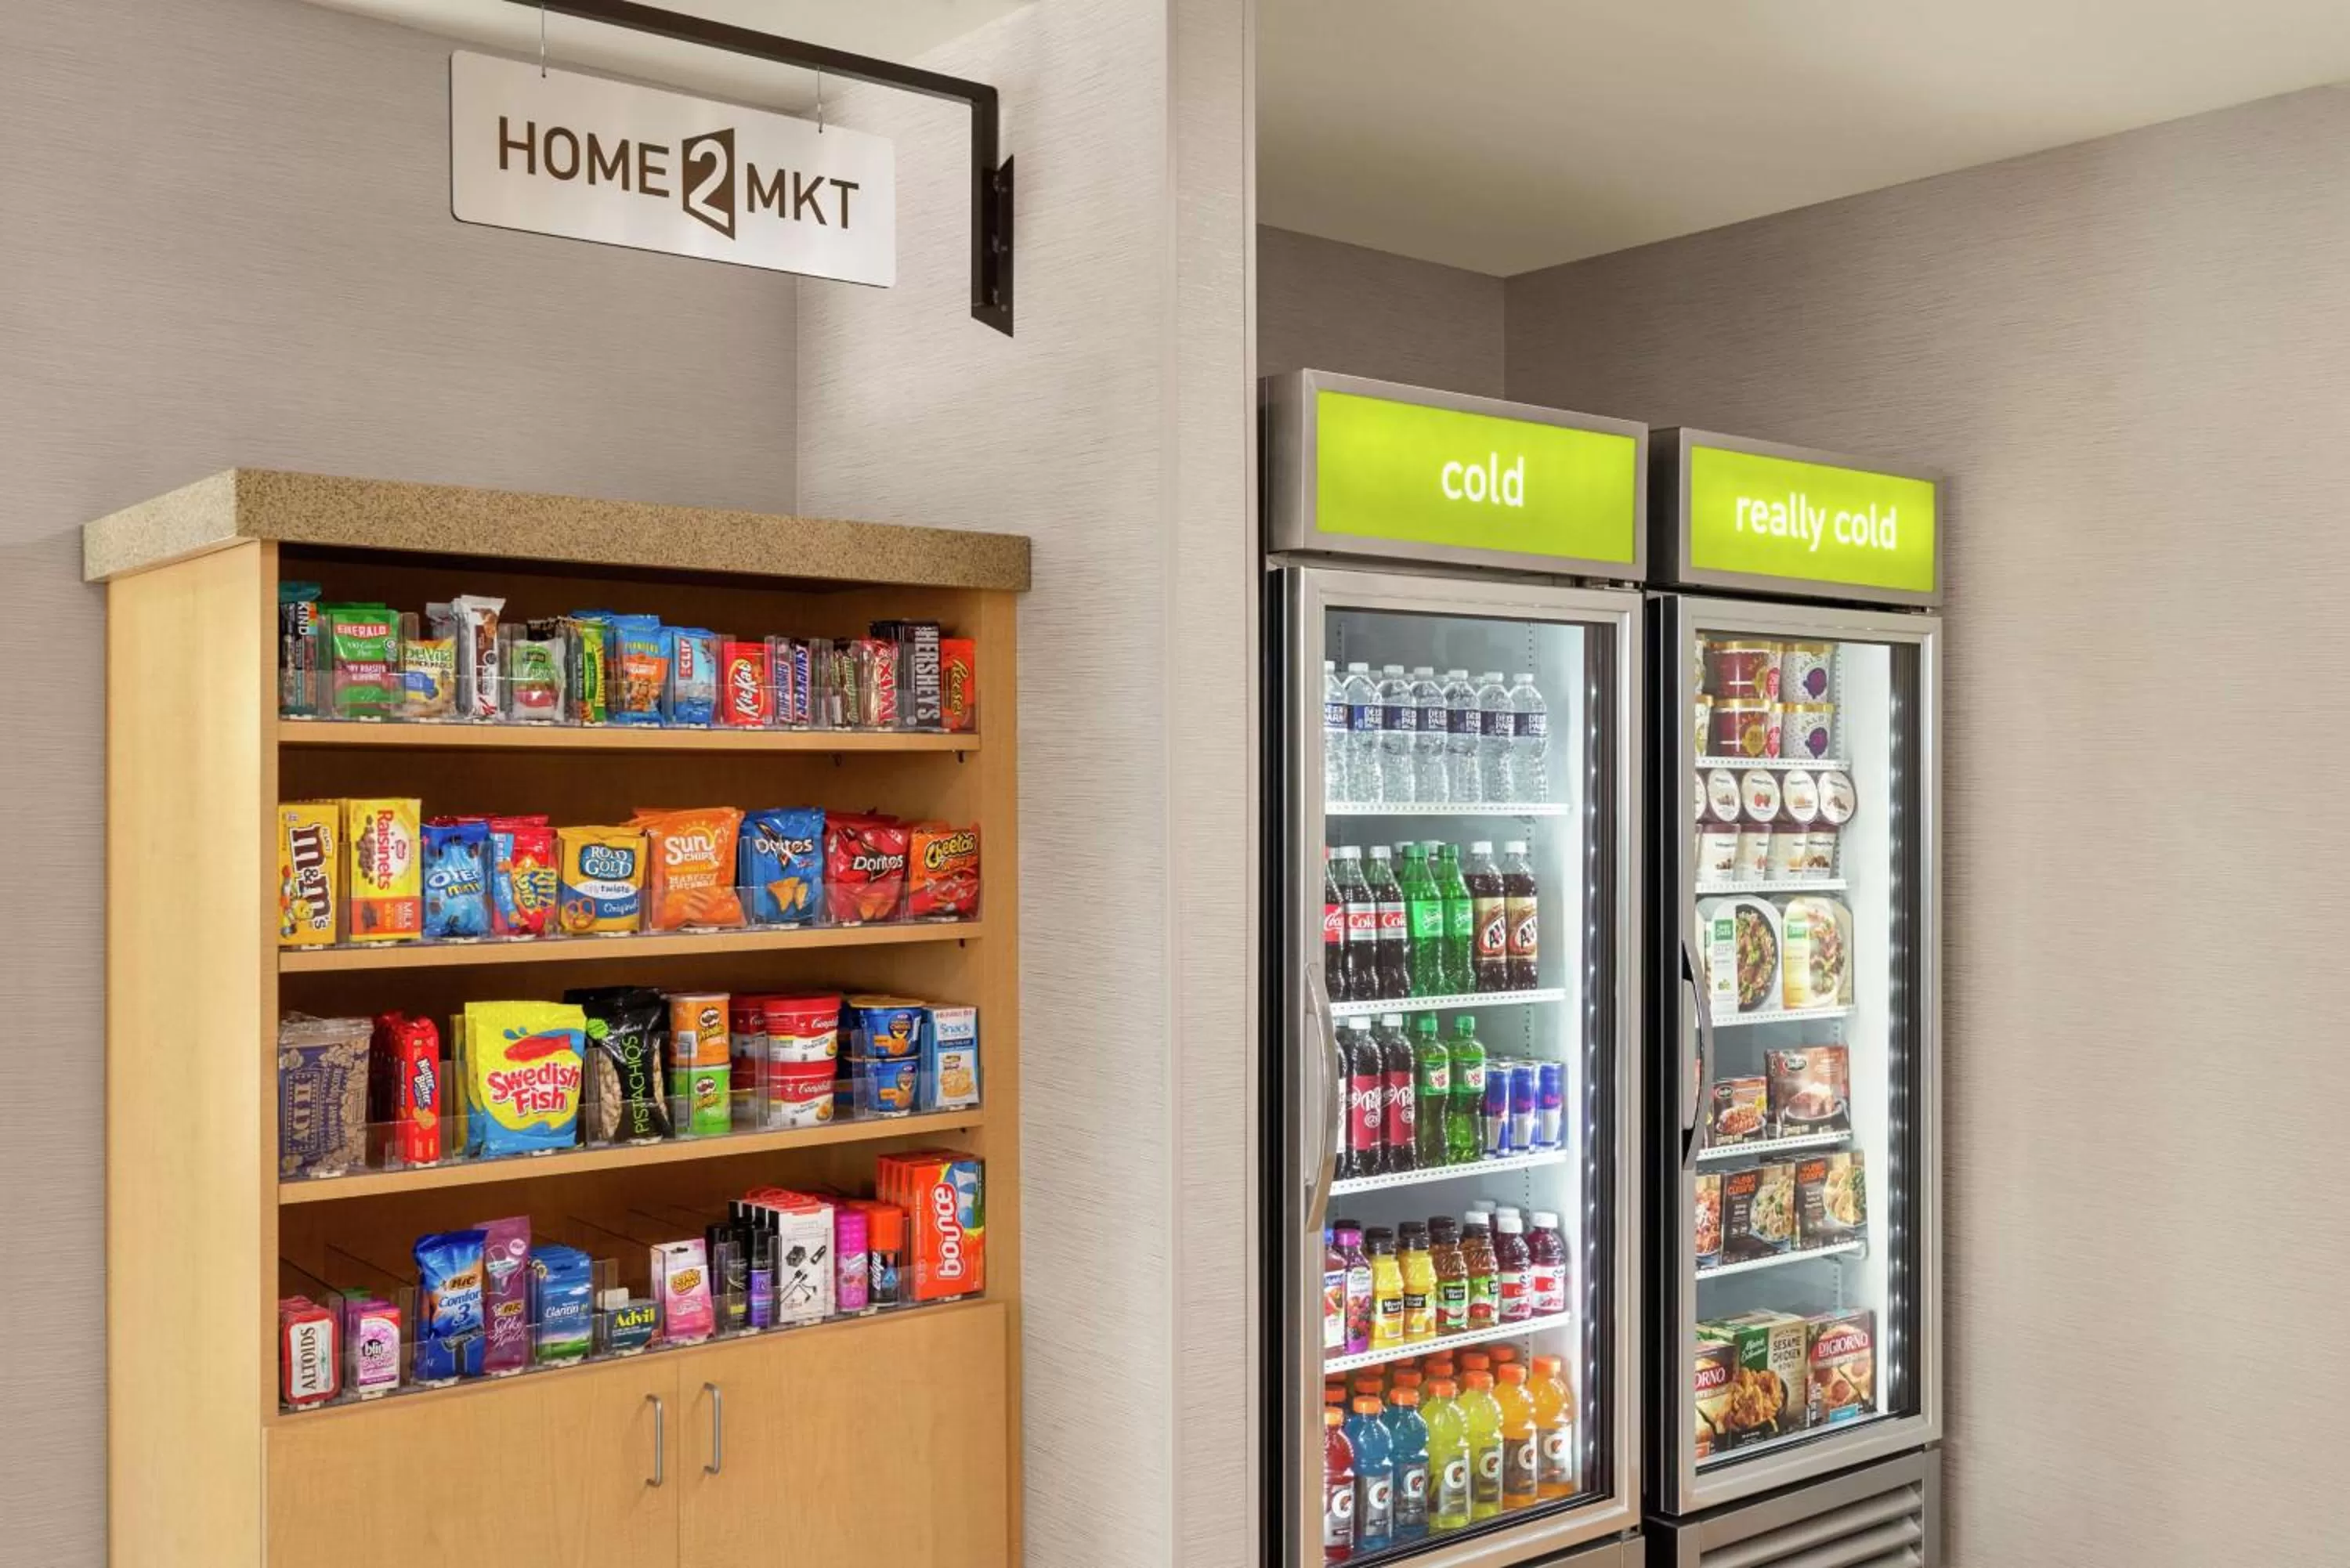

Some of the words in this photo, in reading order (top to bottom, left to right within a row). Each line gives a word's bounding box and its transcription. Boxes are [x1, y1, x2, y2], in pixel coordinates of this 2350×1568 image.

[1441, 453, 1525, 508] cold
[1737, 493, 1826, 551] really
[1835, 501, 1898, 550] cold
[297, 601, 310, 635] KIND
[337, 625, 387, 638] EMERALD
[915, 627, 941, 720] HERSHEY'S
[878, 663, 896, 724] TWIX
[377, 810, 394, 891] Raisinets
[591, 846, 627, 861] ROLD
[665, 835, 715, 865] Sun
[754, 838, 814, 855] Doritos
[925, 833, 976, 869] Cheetos
[585, 859, 633, 877] GOLD
[853, 854, 903, 871] Doritos
[447, 883, 480, 898] mini
[601, 884, 631, 894] twists
[417, 1058, 435, 1090] Nutter
[486, 1062, 581, 1103] Swedish
[624, 1035, 649, 1135] PISTACHIOS
[415, 1075, 432, 1105] Butter
[515, 1087, 567, 1116] Fish
[934, 1187, 963, 1277] bounce
[451, 1275, 476, 1288] BIC
[455, 1303, 471, 1324] 3
[615, 1307, 656, 1327] Advil
[1773, 1335, 1801, 1350] SESAME
[1773, 1347, 1801, 1364] CHICKEN
[1817, 1333, 1869, 1357] DIGIORNO
[301, 1327, 316, 1390] ALTOIDS
